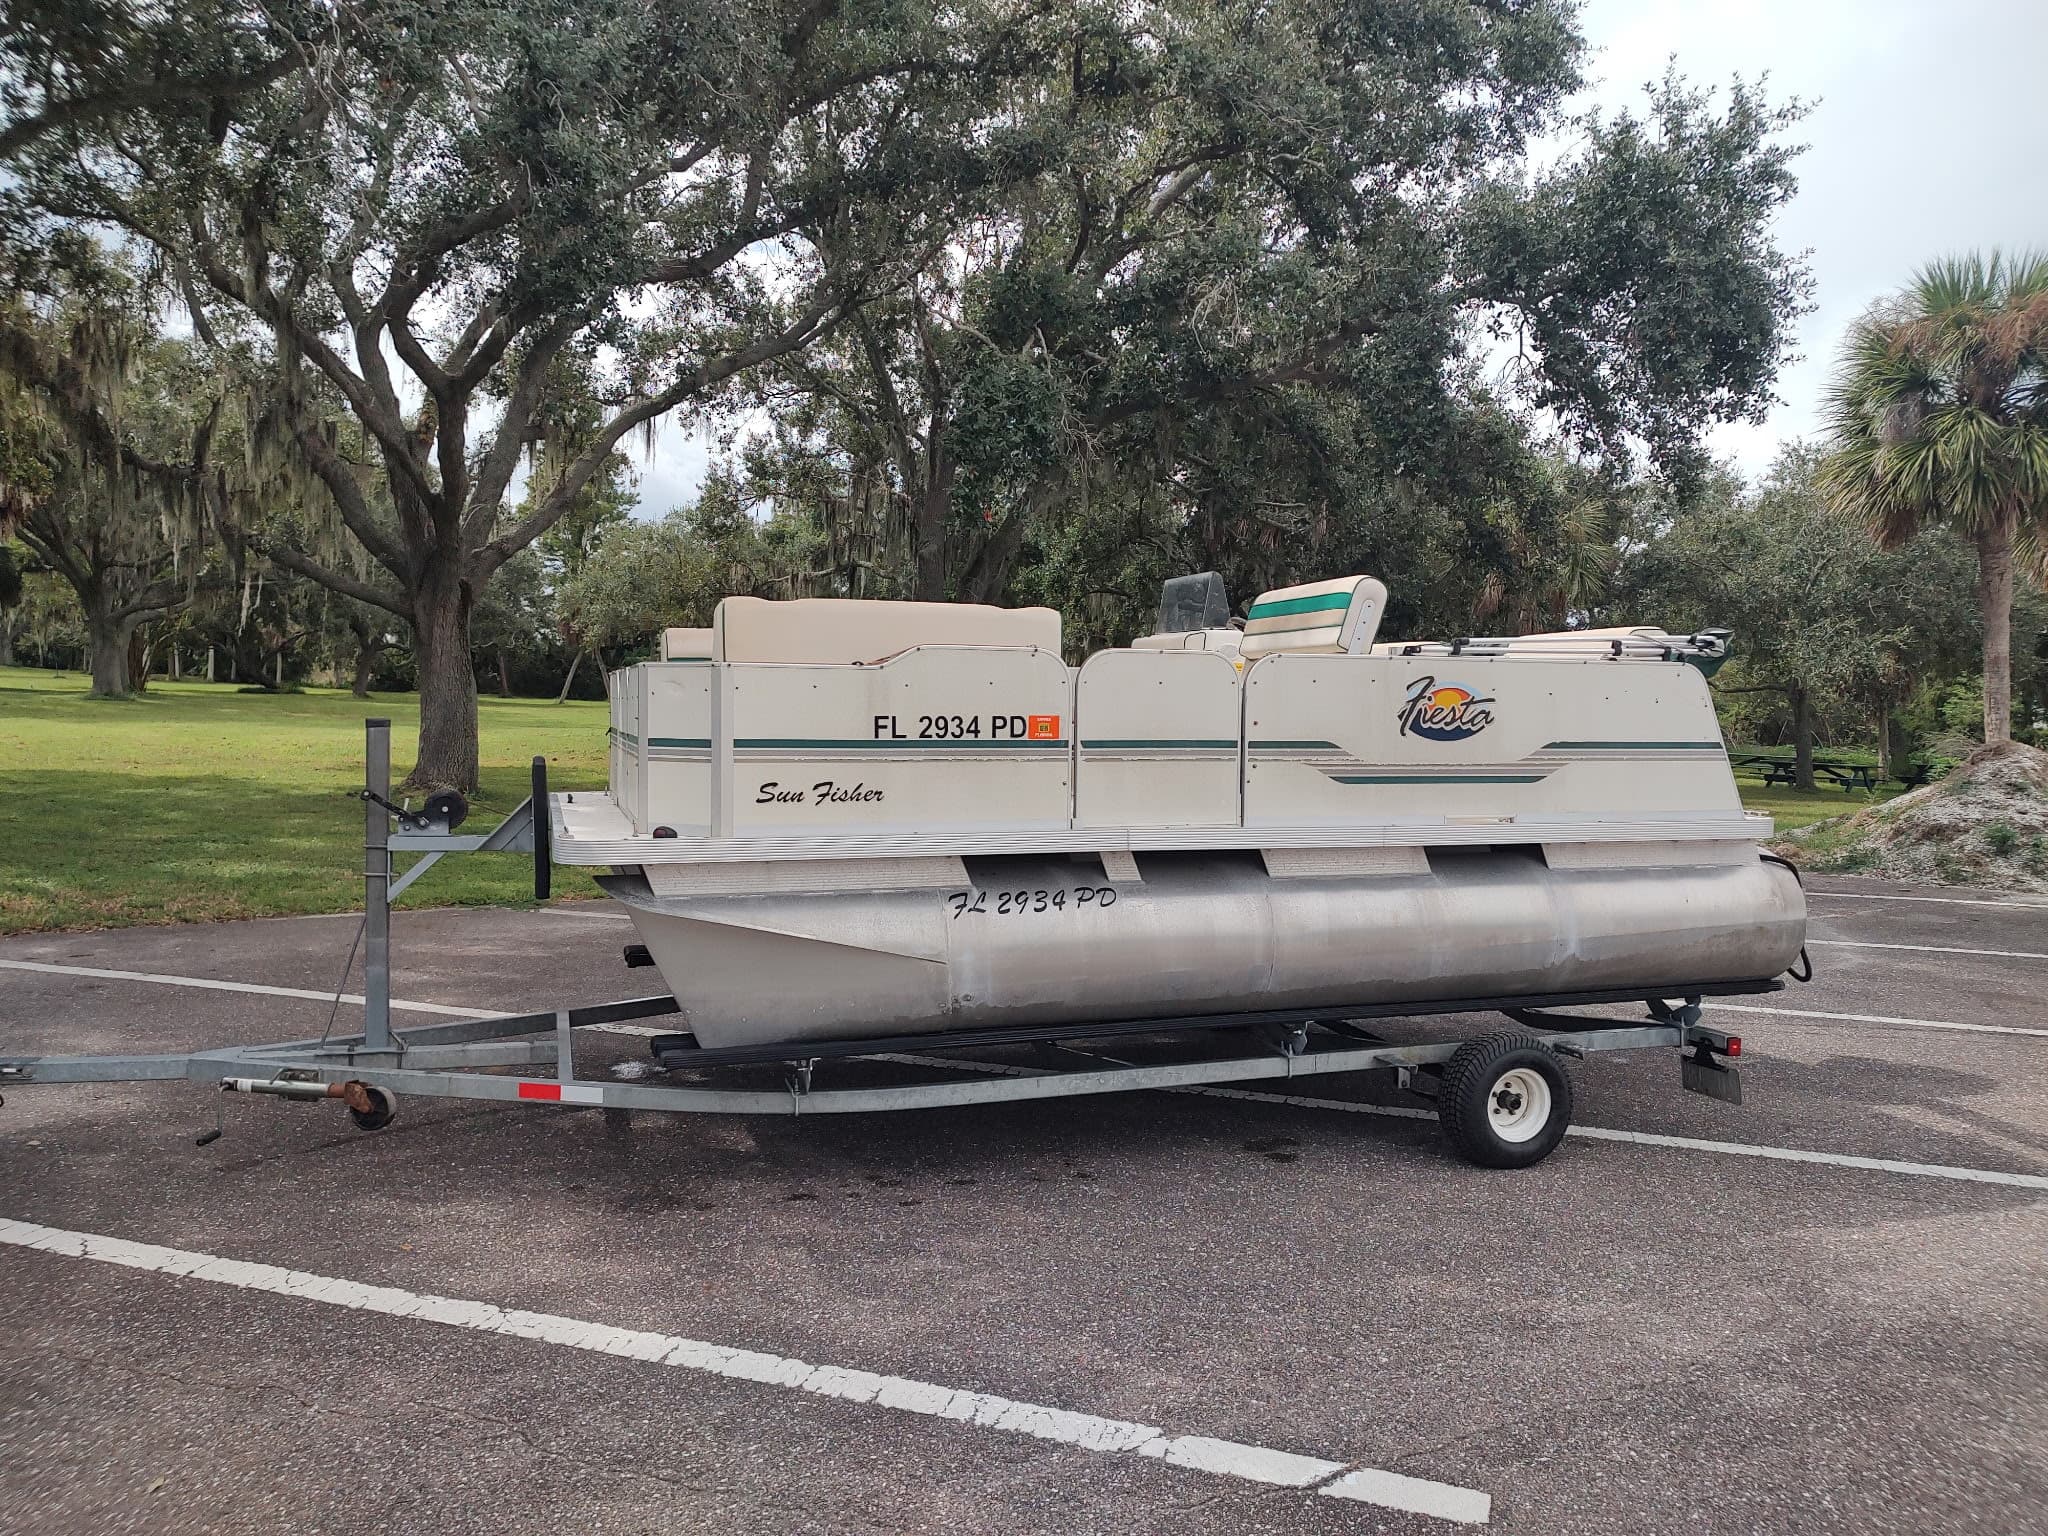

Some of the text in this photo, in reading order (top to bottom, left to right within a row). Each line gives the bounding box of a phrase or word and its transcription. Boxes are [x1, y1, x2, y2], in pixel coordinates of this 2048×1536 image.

[1399, 675, 1496, 736] Fiesta
[873, 715, 1027, 739] FL 2934 PD
[755, 781, 884, 806] Sun Fisher
[948, 886, 1117, 920] FL 2934 PD
